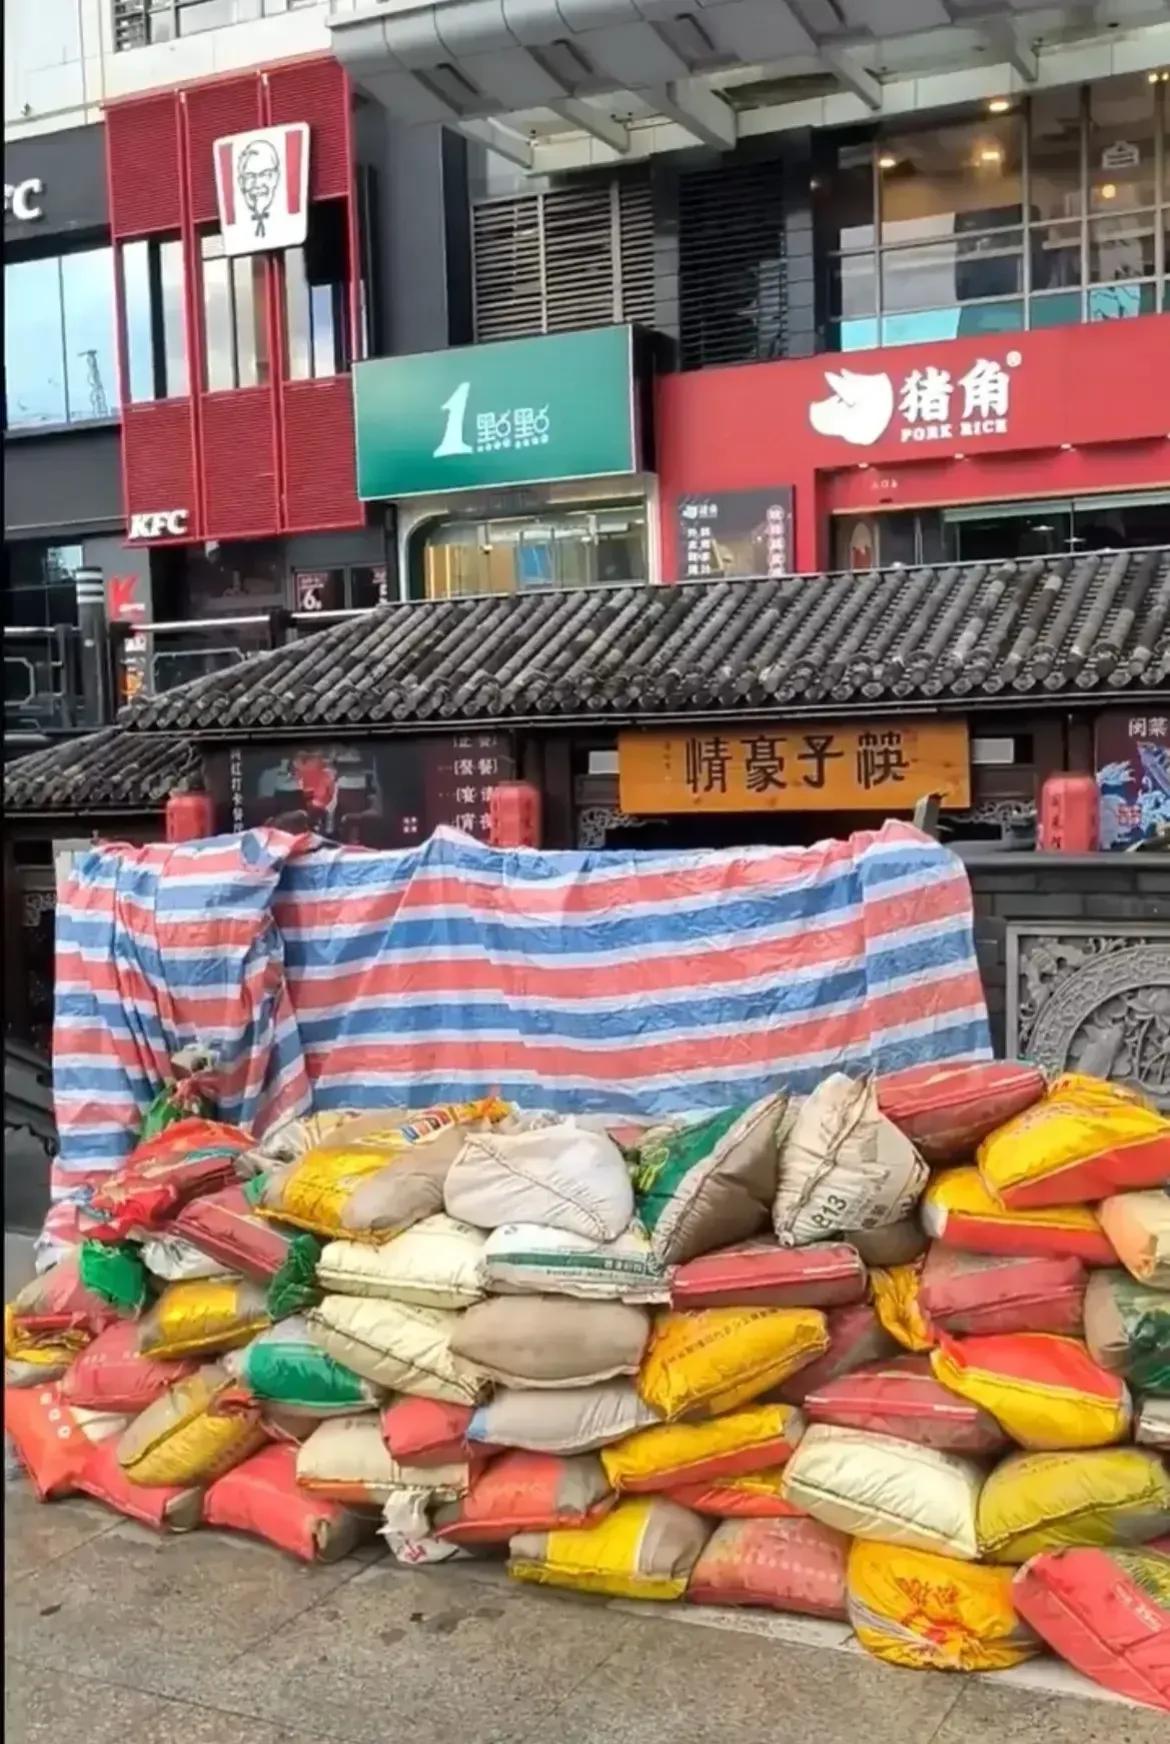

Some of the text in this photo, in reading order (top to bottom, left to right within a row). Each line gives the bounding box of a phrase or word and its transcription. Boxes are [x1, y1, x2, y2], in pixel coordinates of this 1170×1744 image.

[898, 358, 1010, 423] 猪角
[900, 424, 953, 443] PORK
[128, 508, 189, 539] KFC
